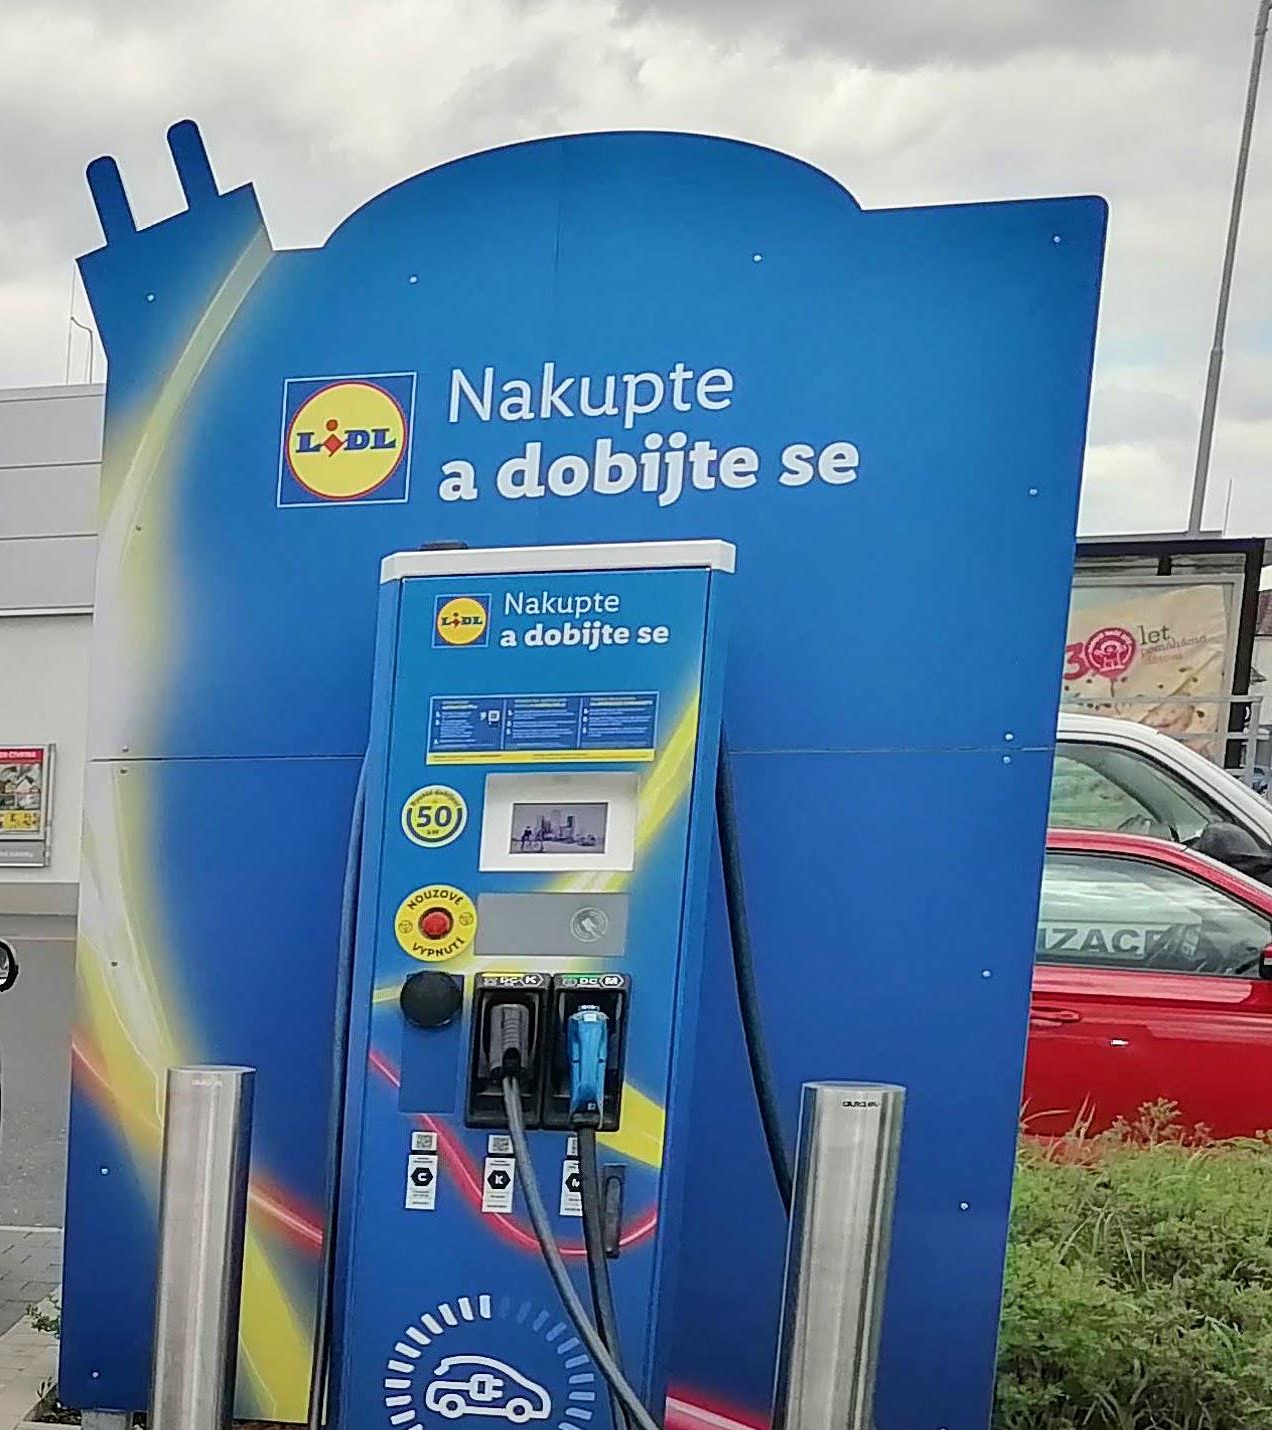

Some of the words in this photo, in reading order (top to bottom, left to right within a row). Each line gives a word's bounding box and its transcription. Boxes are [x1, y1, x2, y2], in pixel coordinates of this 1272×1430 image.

[447, 362, 734, 427] Nakupte
[439, 460, 478, 502] a
[496, 432, 760, 508] dobijte
[778, 440, 860, 487] se
[503, 591, 621, 619] Nakupte
[500, 629, 518, 647] a
[524, 622, 630, 651] dobijte
[636, 625, 670, 645] se
[1138, 625, 1170, 645] let
[416, 805, 452, 828] 50
